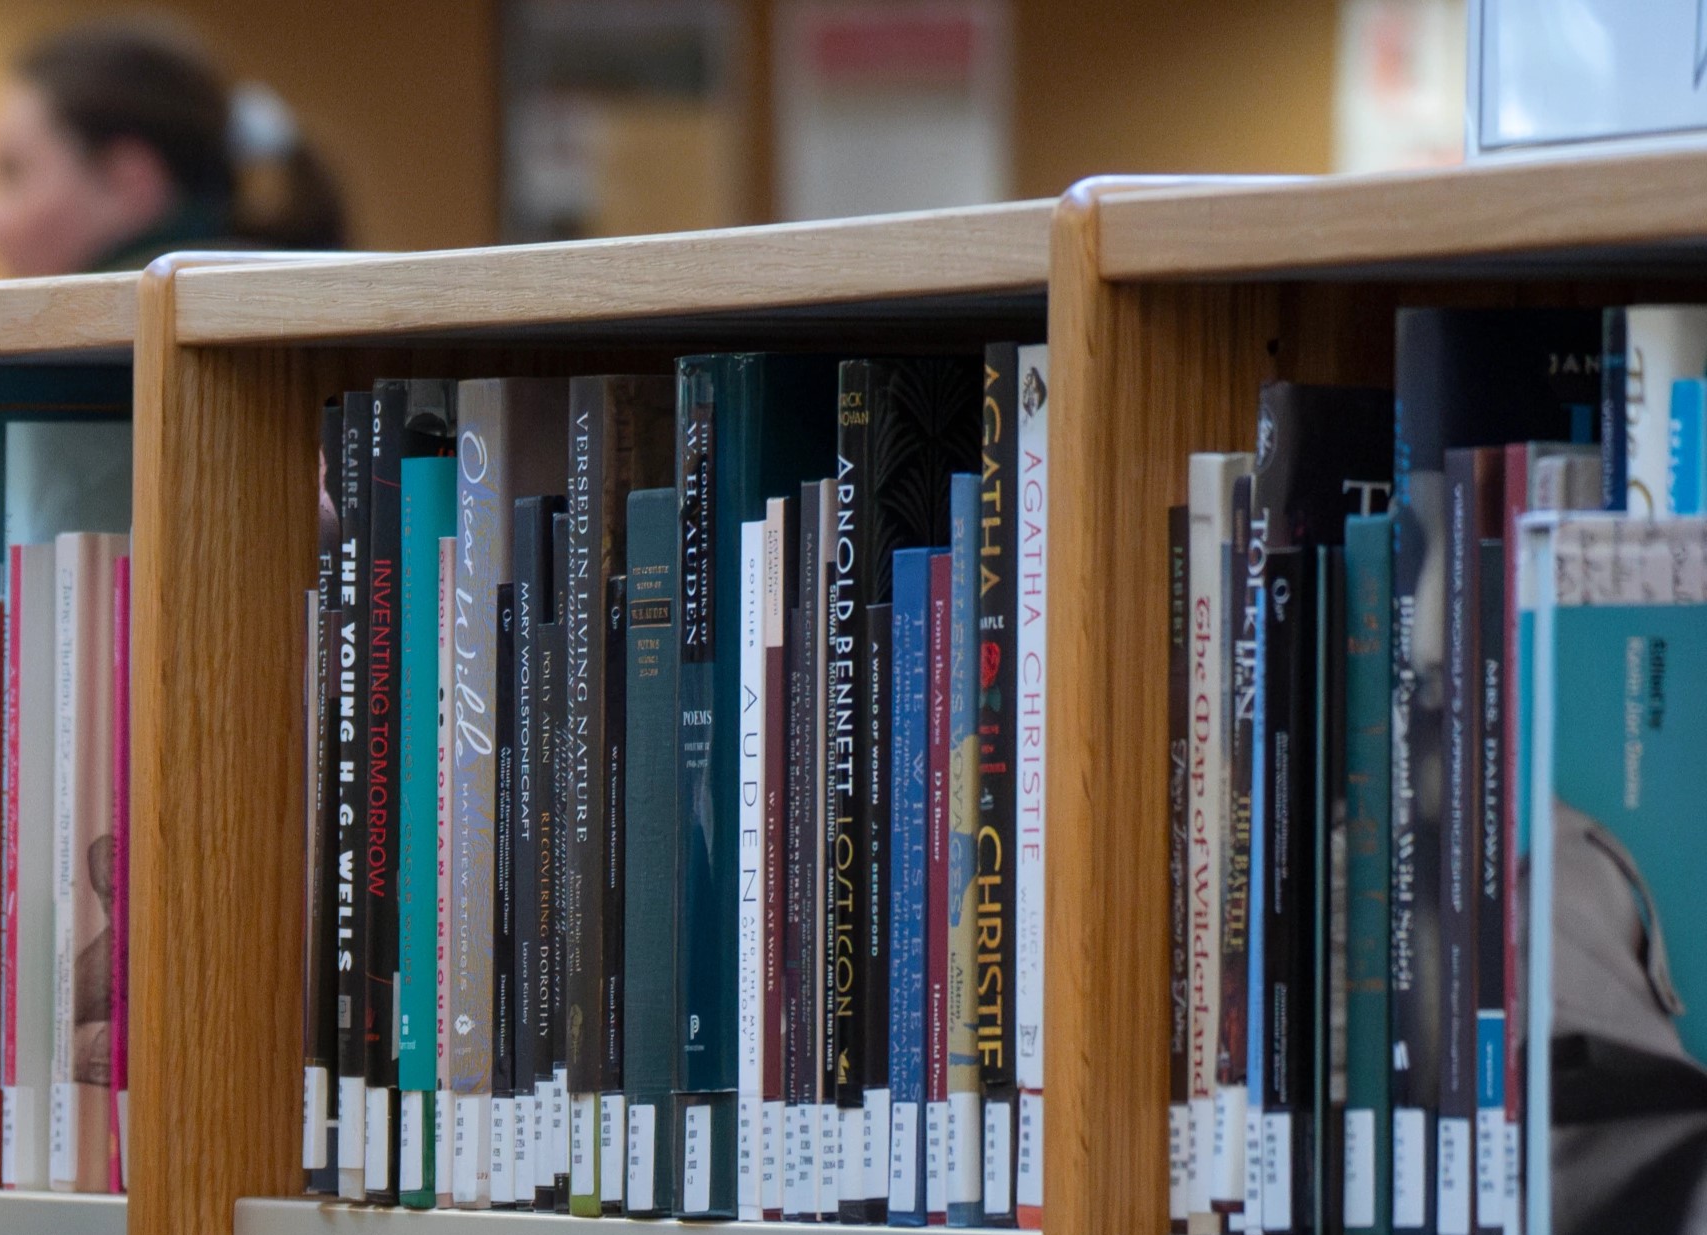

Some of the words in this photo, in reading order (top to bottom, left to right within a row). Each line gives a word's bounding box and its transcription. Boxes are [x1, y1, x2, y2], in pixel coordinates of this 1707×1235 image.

[347, 427, 360, 511] CLAIRE
[371, 399, 382, 458] COLE
[575, 410, 589, 535] VERSED
[686, 420, 698, 460] W.
[459, 429, 488, 575] Oscar
[686, 473, 698, 505] H.
[979, 364, 1003, 600] AGATHA
[340, 537, 358, 606] THE
[576, 549, 588, 580] IN
[836, 454, 856, 621] ARNOLD
[1023, 451, 1044, 628] AGATHA
[521, 582, 531, 638] MARY
[686, 520, 698, 647] AUDEN
[828, 584, 837, 646] SCHWAB
[934, 599, 944, 648] From
[339, 621, 357, 743] YOUNG
[370, 558, 392, 715] INVENTING
[454, 587, 493, 770] Wilde
[576, 592, 589, 703] LIVING
[871, 642, 880, 652] A
[912, 610, 925, 713] THE
[934, 653, 943, 681] the
[1194, 597, 1211, 683] The
[683, 710, 712, 727] POEMS
[827, 662, 837, 738] MOMENTS
[835, 636, 855, 797] BENNETT
[871, 657, 880, 716] WORLD
[871, 719, 880, 742] OF
[933, 688, 943, 746] Abyss
[1485, 657, 1500, 732] MRS.
[520, 645, 531, 841] WOLLSTONECRAFT
[575, 715, 588, 843] NATURE
[827, 742, 836, 768] FOR
[871, 744, 880, 805] WOMEN
[1021, 650, 1043, 868] CHRISTIE
[1188, 695, 1211, 785] Map
[338, 760, 355, 841] H.G.
[367, 723, 389, 898] TOMORROW
[742, 684, 759, 902] AUDEN
[826, 771, 836, 843] NOTHING
[1192, 823, 1211, 852] of
[1483, 737, 1500, 900] DALLOWAY
[337, 849, 354, 973] WELLS
[540, 811, 551, 937] RECOVERING
[742, 915, 748, 937] OF
[836, 924, 854, 1017] ICON
[909, 750, 924, 1103] WHISPERERS
[977, 825, 1003, 1069] CHRISTIE
[539, 943, 550, 1040] DOROTHY
[1189, 856, 1210, 1099] Wilderland
